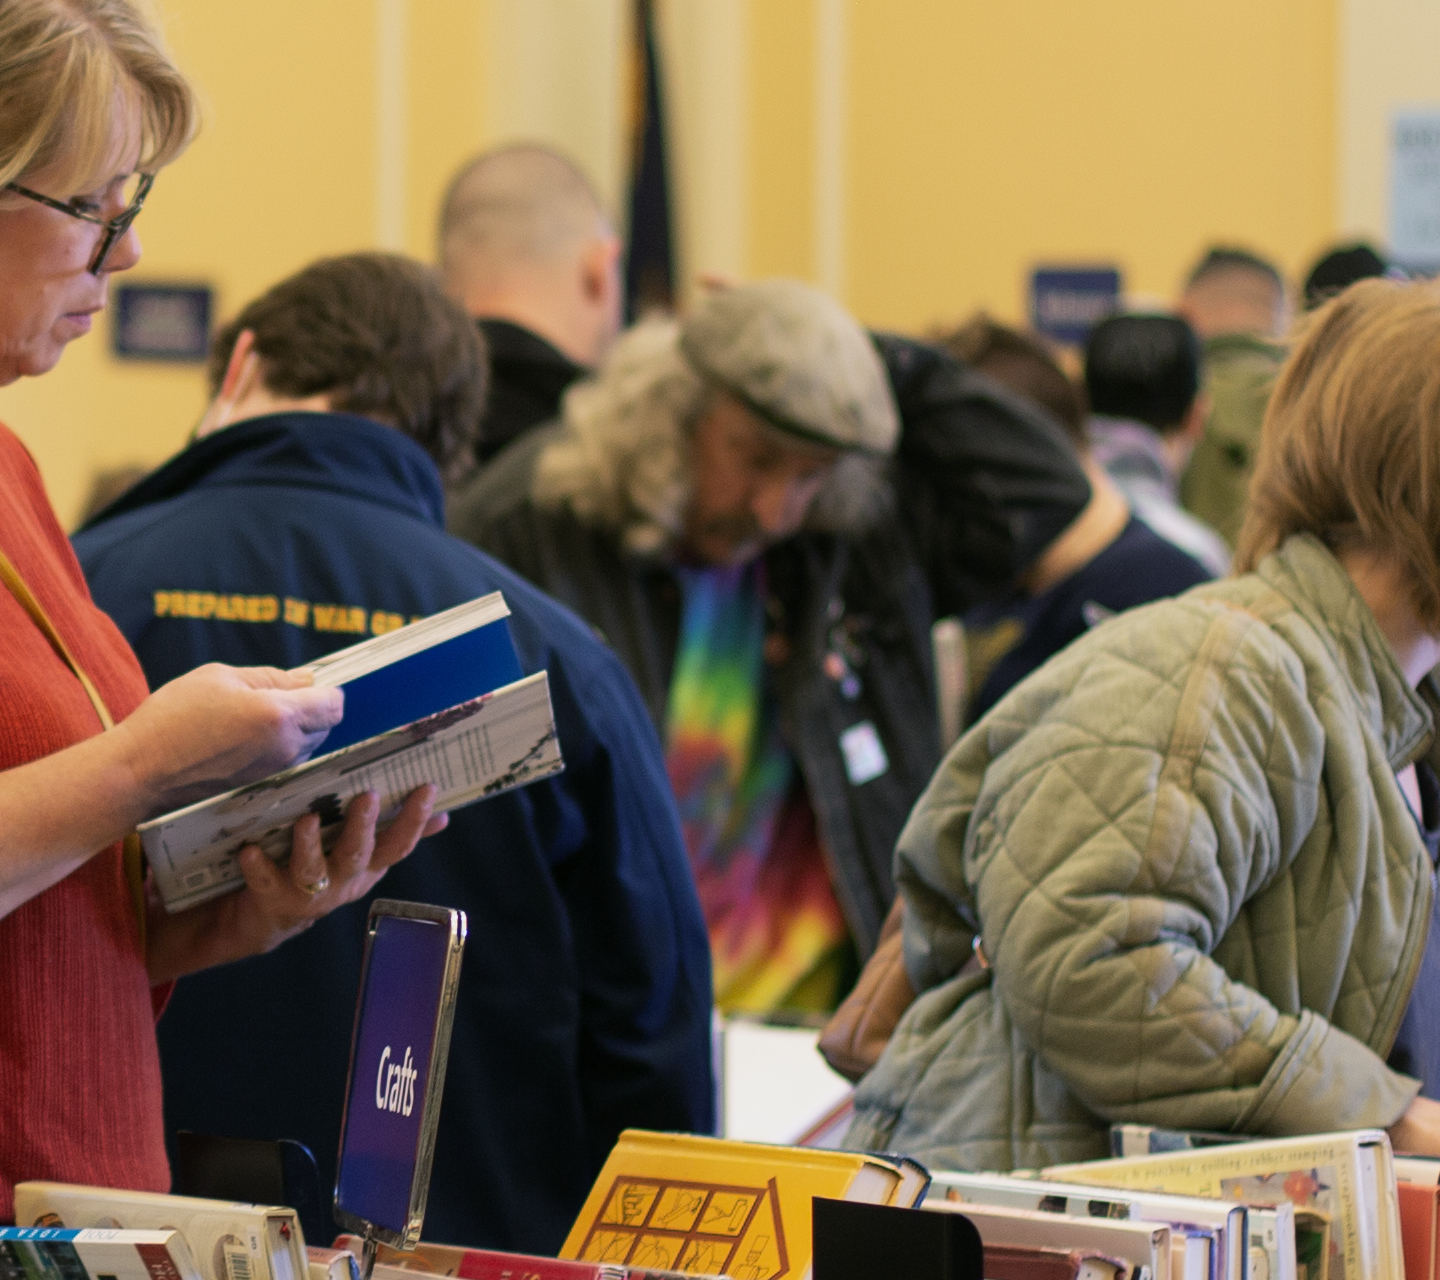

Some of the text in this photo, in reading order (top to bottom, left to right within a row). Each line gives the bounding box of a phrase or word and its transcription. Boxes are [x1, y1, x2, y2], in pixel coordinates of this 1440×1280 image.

[154, 590, 366, 633] PREPARED IN WAR
[376, 1046, 418, 1117] Crafts
[17, 1229, 60, 1239] IDEA
